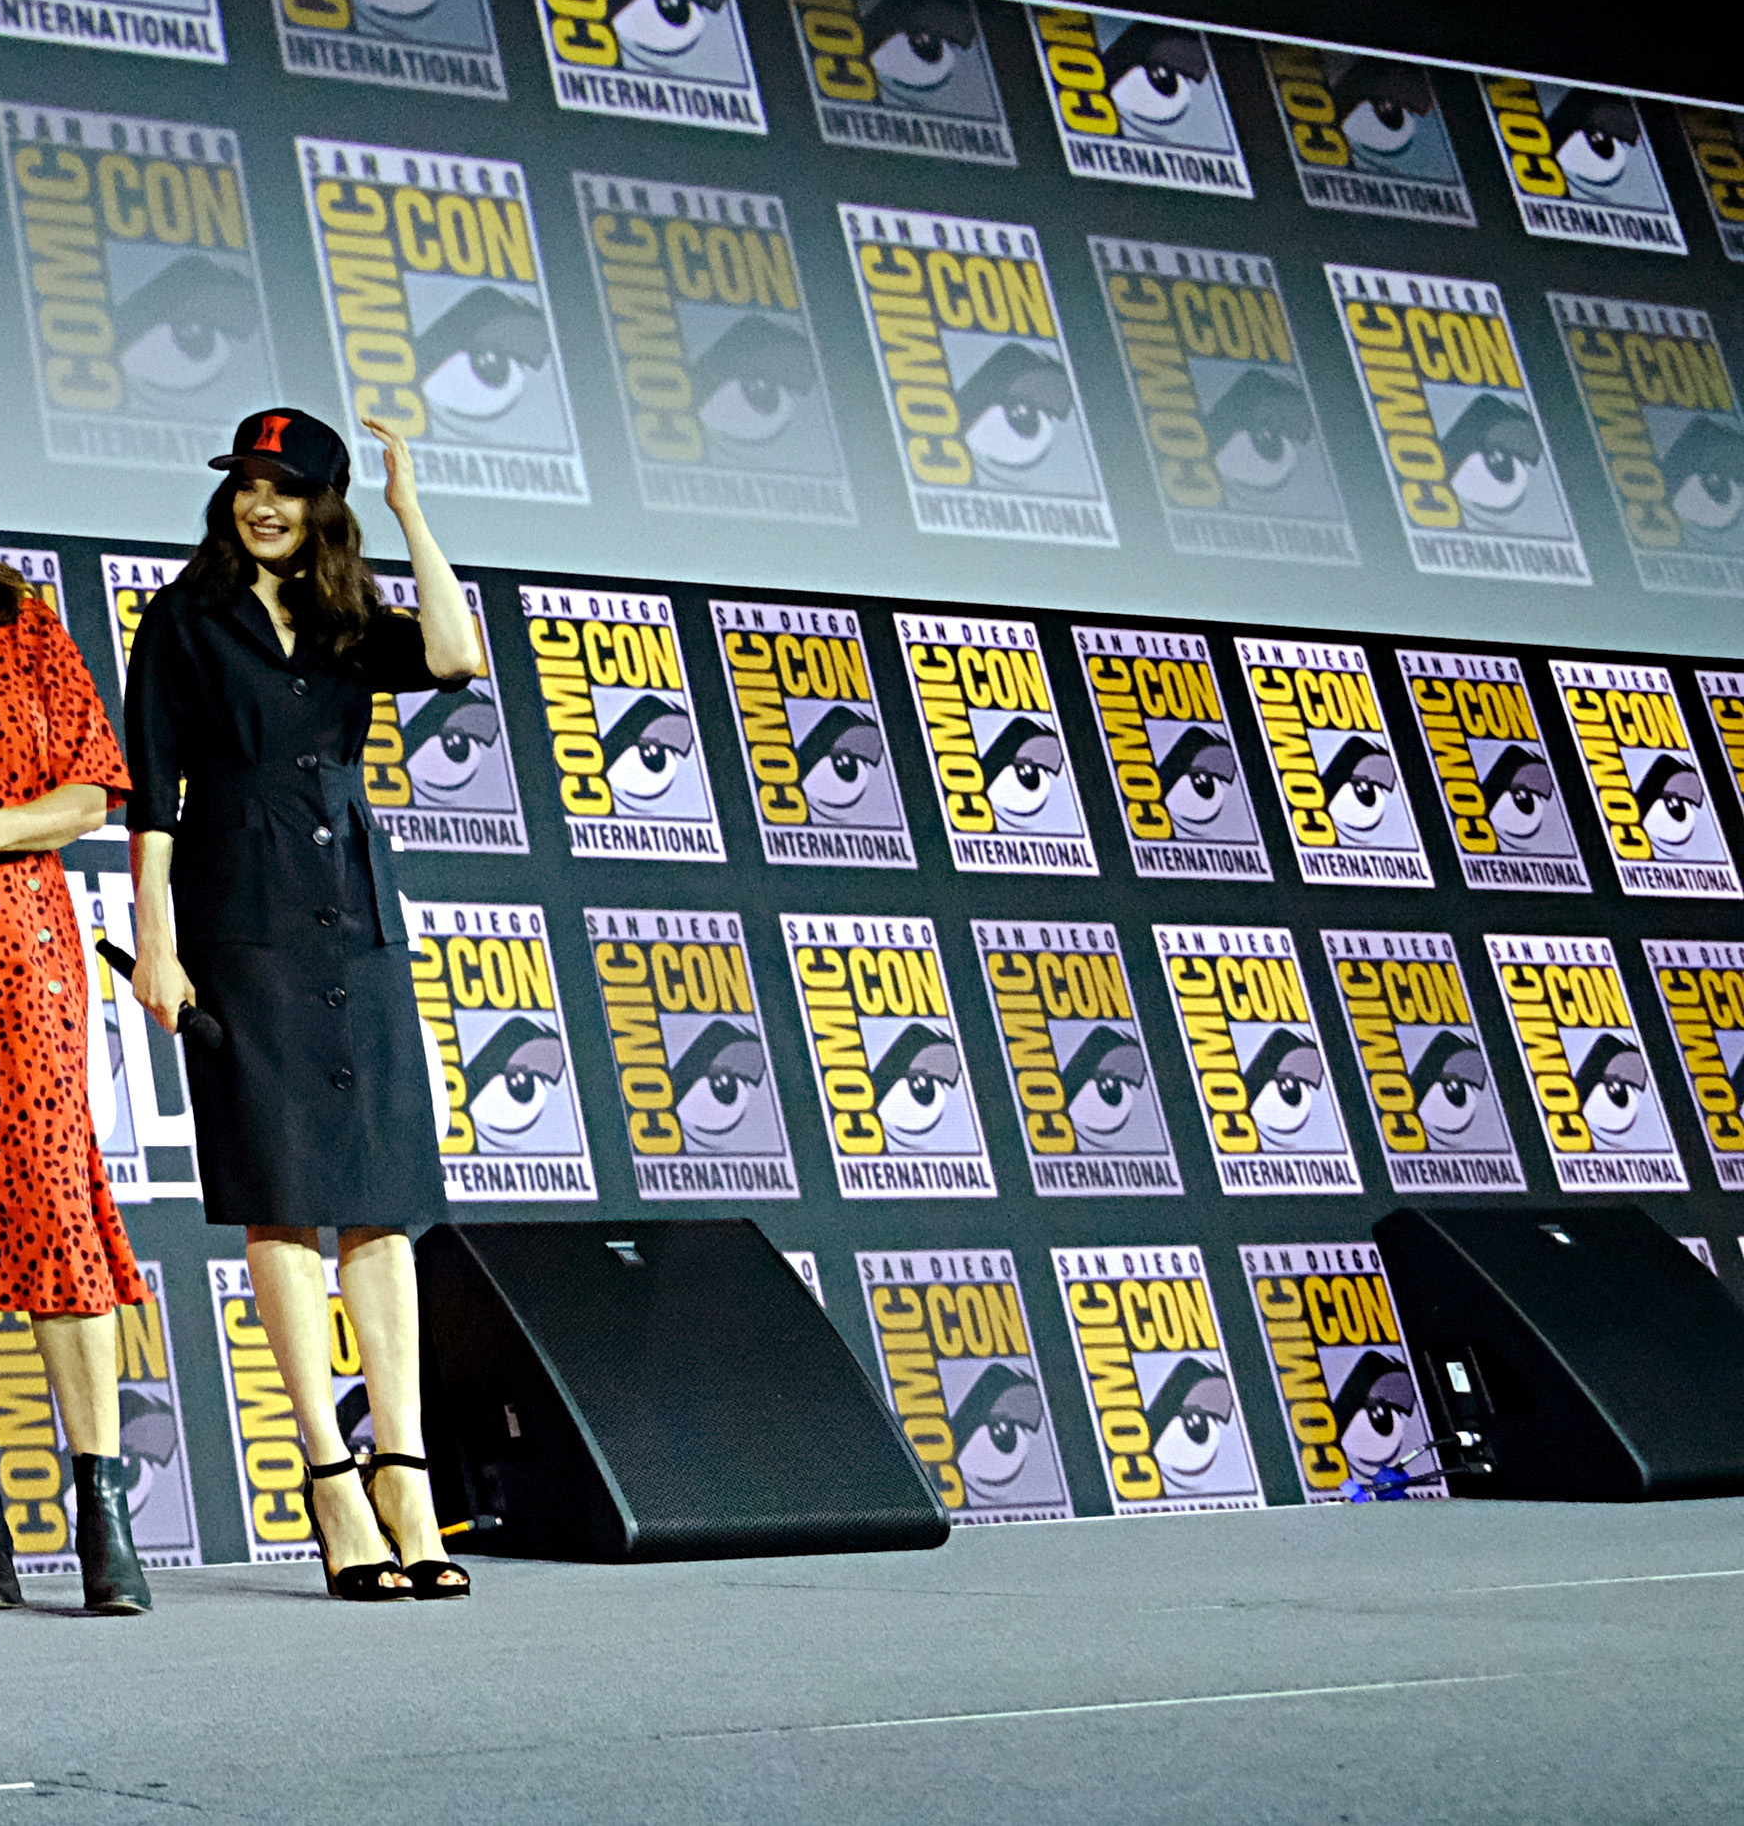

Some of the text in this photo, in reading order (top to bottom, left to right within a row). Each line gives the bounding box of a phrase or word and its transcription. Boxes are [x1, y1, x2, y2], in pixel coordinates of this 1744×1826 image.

[559, 71, 760, 126] INTERNATIONAL
[1067, 138, 1246, 189] INTERNATIONAL
[846, 211, 1036, 258] SAN DIEGO
[1524, 200, 1683, 248] INTERNATIONAL
[925, 249, 1058, 340] CON
[1331, 270, 1500, 313] SAN DIEGO
[857, 243, 975, 488] COMIC
[1403, 306, 1525, 391] CON
[1344, 300, 1462, 531] COMIC
[915, 491, 1112, 540] INTERNATIONAL
[1412, 534, 1586, 578] INTERNATIONAL
[715, 605, 857, 636] SAN DIEGO
[899, 618, 1036, 648] SAN DIEGO
[773, 633, 873, 702] CON
[956, 645, 1053, 713] CON
[1239, 642, 1365, 671] SAN DIEGO
[1554, 665, 1670, 691] SAN DIEGO
[1292, 667, 1384, 733] CON
[1604, 688, 1690, 751] CON
[723, 630, 810, 826] COMIC
[908, 643, 995, 834] COMIC
[1249, 665, 1338, 848] COMIC
[1564, 687, 1653, 861] COMIC
[764, 829, 912, 862] INTERNATIONAL
[953, 837, 1094, 869] INTERNATIONAL
[1299, 851, 1430, 881] INTERNATIONAL
[1619, 864, 1739, 893] INTERNATIONAL
[786, 919, 933, 946] SAN DIEGO
[1158, 930, 1292, 955] SAN DIEGO
[1489, 939, 1613, 964] SAN DIEGO
[846, 946, 950, 1019] CON
[1214, 955, 1311, 1024] CON
[1542, 963, 1633, 1030] CON
[795, 946, 886, 1156] COMIC
[1168, 955, 1260, 1154] COMIC
[1500, 963, 1593, 1153] COMIC
[839, 1161, 992, 1190] INTERNATIONAL
[1219, 1158, 1358, 1187] INTERNATIONAL
[1556, 1157, 1684, 1185] INTERNATIONAL
[1118, 1277, 1219, 1351] CON
[1068, 1281, 1164, 1500] COMIC
